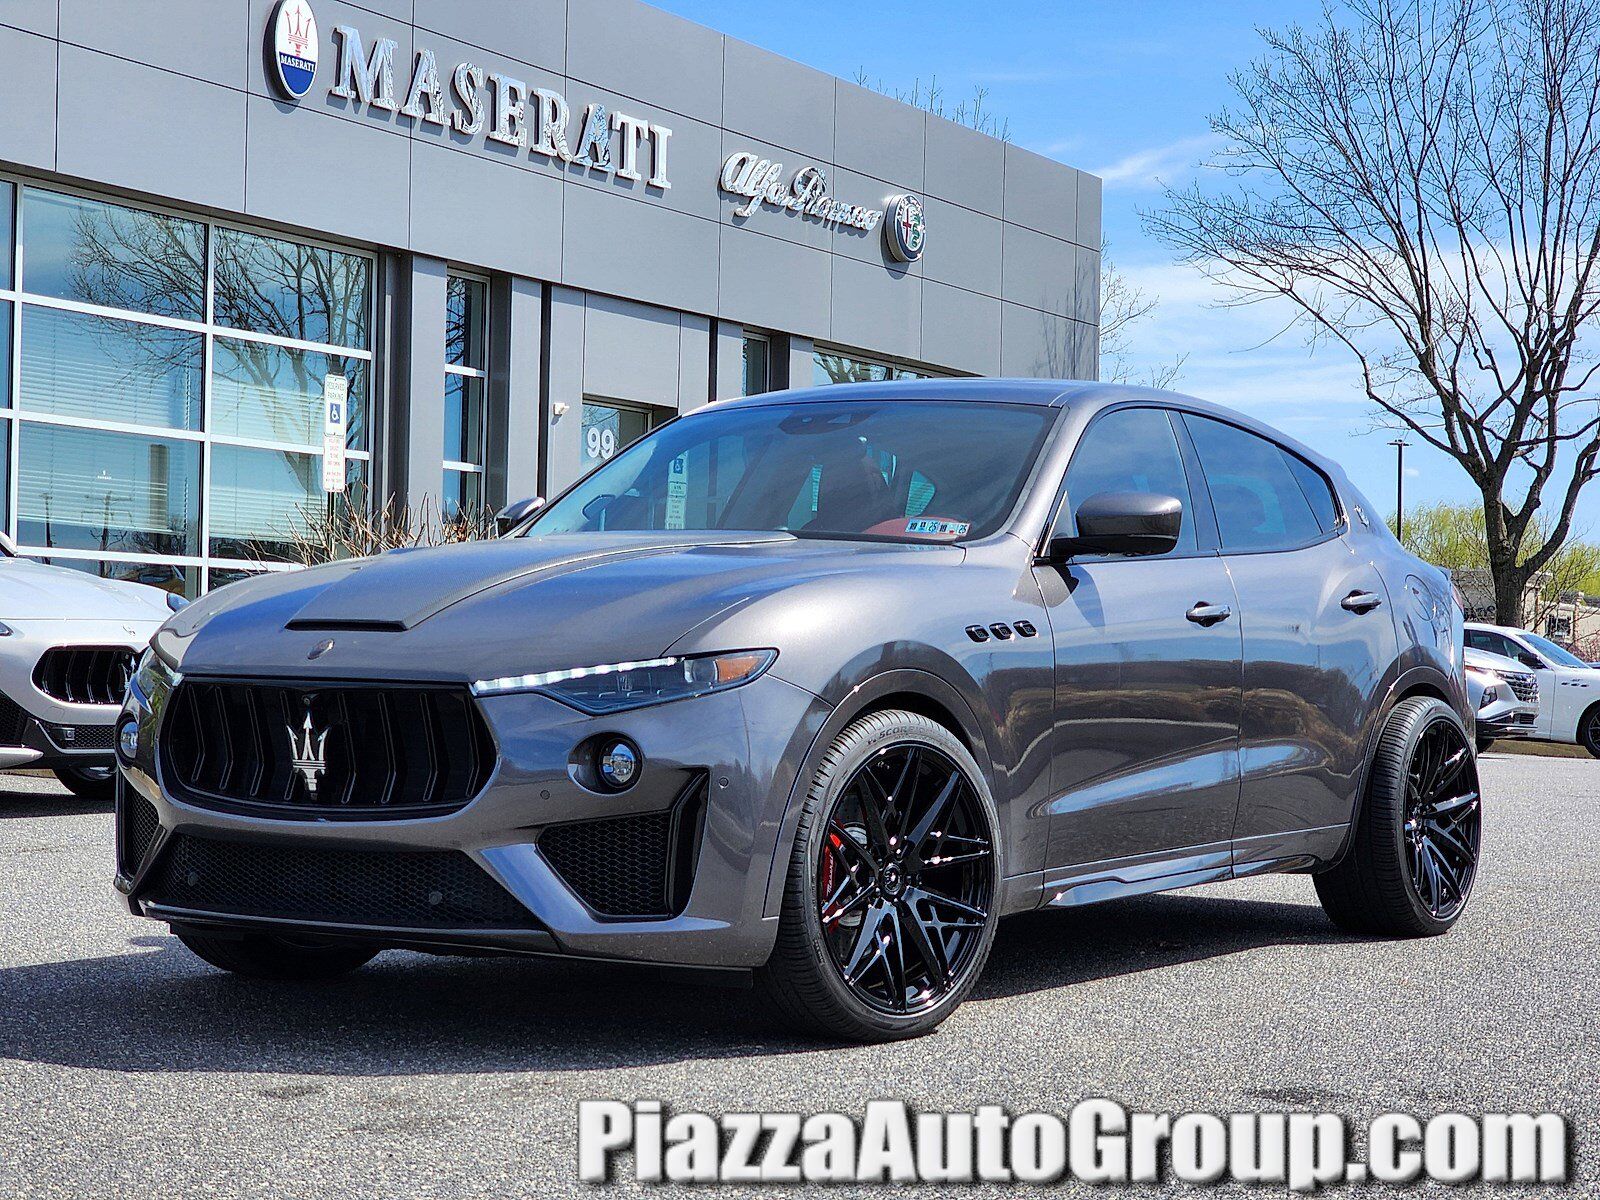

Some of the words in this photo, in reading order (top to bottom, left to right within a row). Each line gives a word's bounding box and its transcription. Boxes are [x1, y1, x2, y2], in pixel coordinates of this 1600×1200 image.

[280, 54, 315, 73] MASERATI
[327, 24, 674, 190] MASERATI
[786, 166, 883, 231] Romeo
[586, 427, 615, 460] 99
[959, 525, 967, 534] 25
